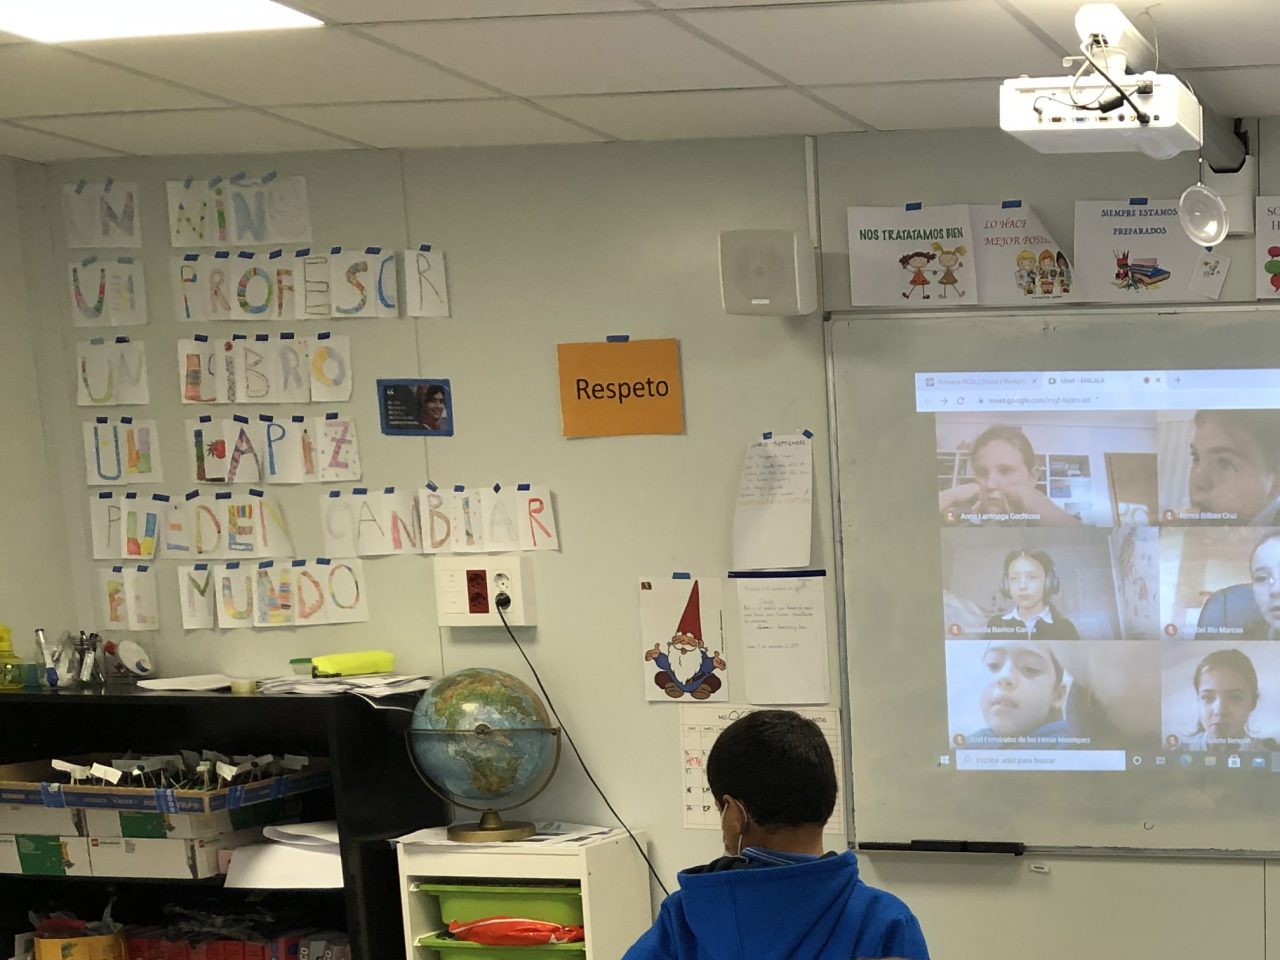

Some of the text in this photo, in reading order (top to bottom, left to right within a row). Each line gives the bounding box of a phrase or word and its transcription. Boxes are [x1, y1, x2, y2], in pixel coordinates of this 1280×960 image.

[1101, 207, 1178, 217] SIEMPRE ESTAMOS
[859, 227, 963, 240] NOS TRATATAMOS BIEN
[1113, 227, 1167, 236] PREPARADOS
[576, 378, 669, 403] Respeto
